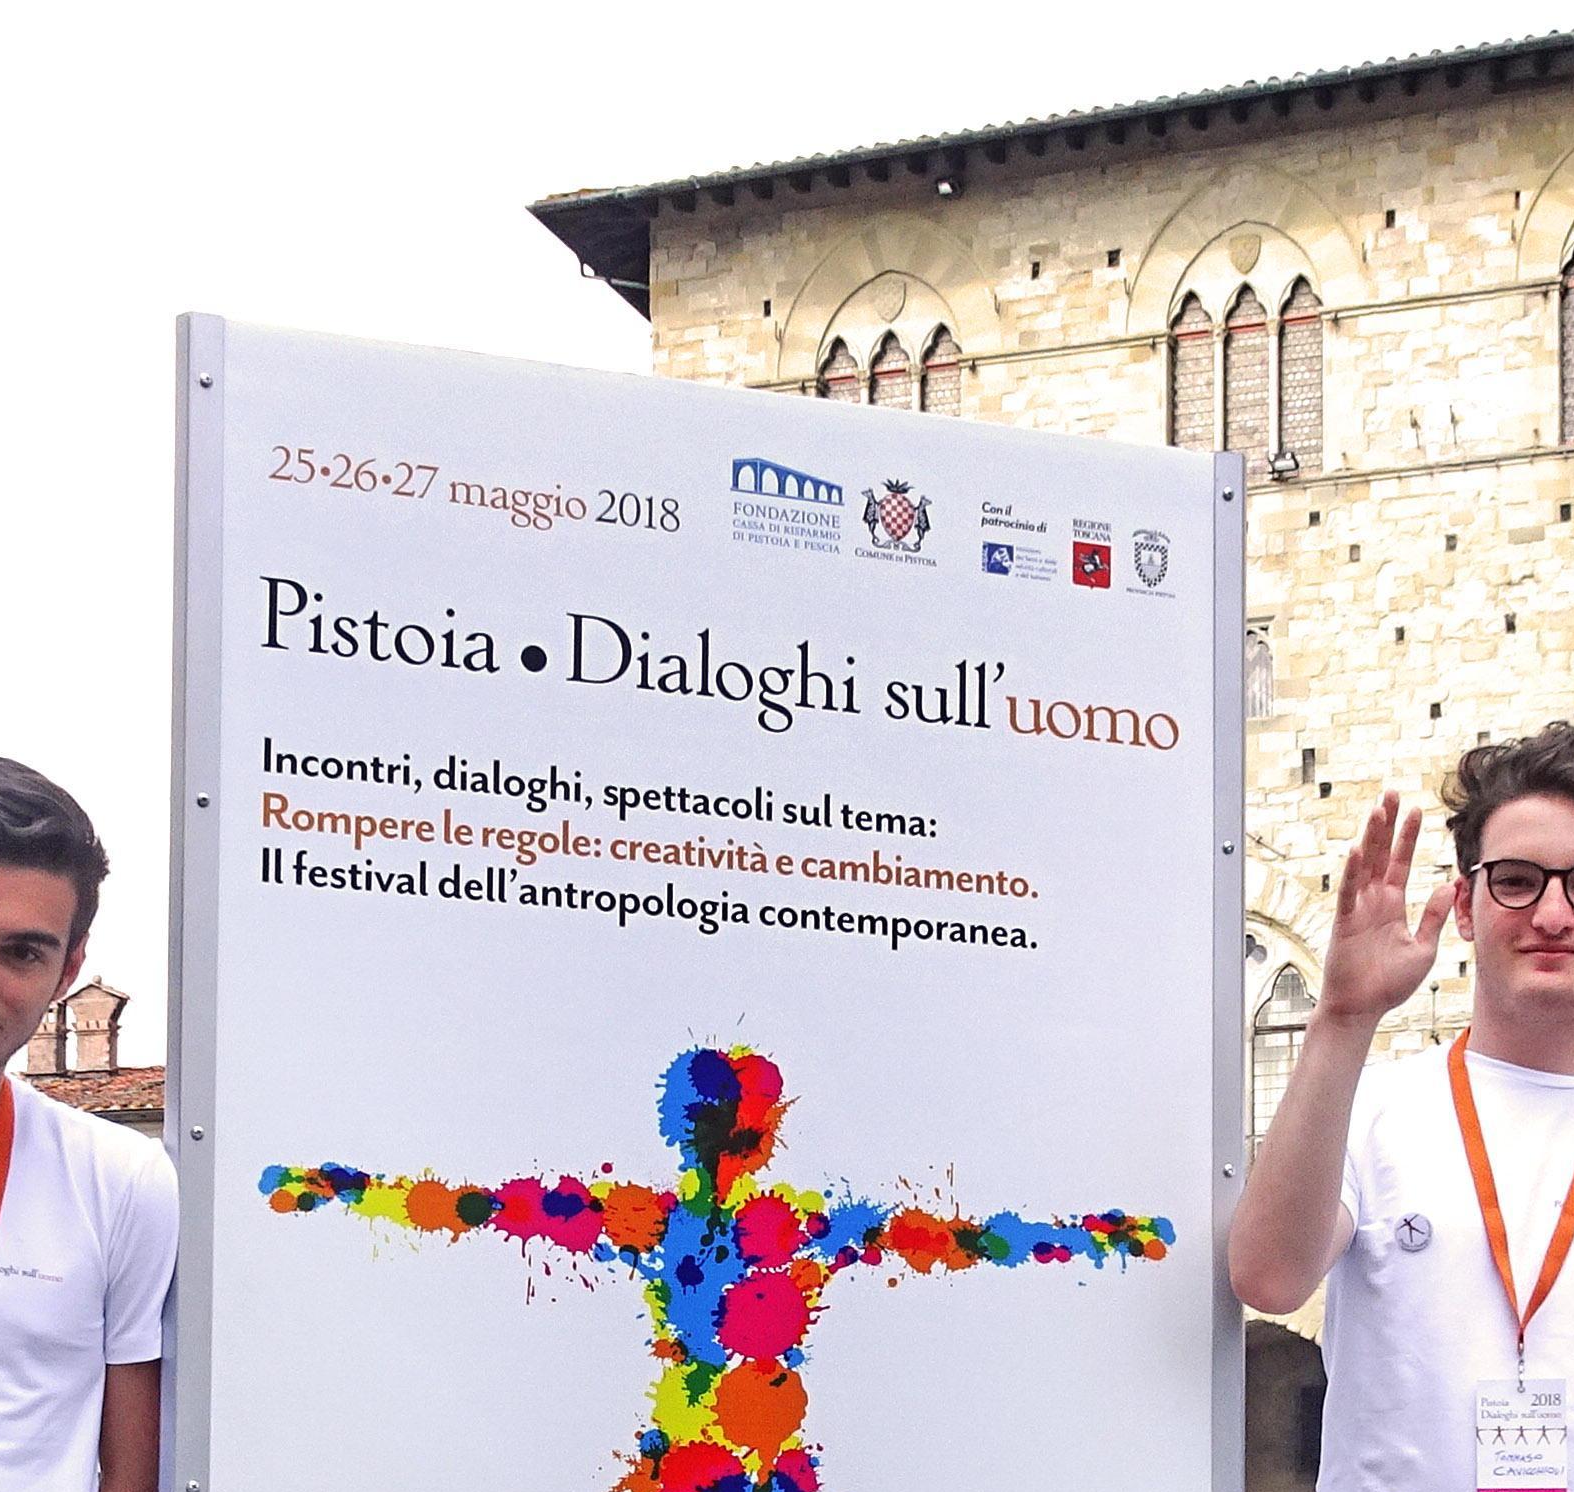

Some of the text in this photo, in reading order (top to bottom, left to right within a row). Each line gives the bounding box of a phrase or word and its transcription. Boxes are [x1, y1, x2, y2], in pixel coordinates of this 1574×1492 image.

[449, 481, 586, 530] maggio
[595, 490, 680, 532] 2018
[733, 502, 841, 529] FONDAZIONE
[982, 501, 1012, 516] Con il
[732, 519, 841, 541] CASSA DI RISPARMIO
[981, 516, 1047, 533] patrocinio di
[1073, 519, 1112, 533] REGIONE
[1073, 529, 1111, 542] TOSCANA
[732, 532, 840, 554] DI PISTOIA E PESCIA
[259, 576, 500, 674] Pistoia
[566, 612, 861, 733] Dialoghi
[885, 659, 1179, 750] sull'uomo
[264, 737, 936, 838] Incontri, dialoghi, spettacoli sul tema:
[263, 792, 1038, 900] Rompere le regole: creatività e cambiamento.
[262, 847, 1037, 951] Il festival dell'antropologia contemporanea.
[1481, 1397, 1509, 1407] Pistoia
[1531, 1393, 1561, 1406] 2018
[1481, 1410, 1518, 1421] Dialoghi
